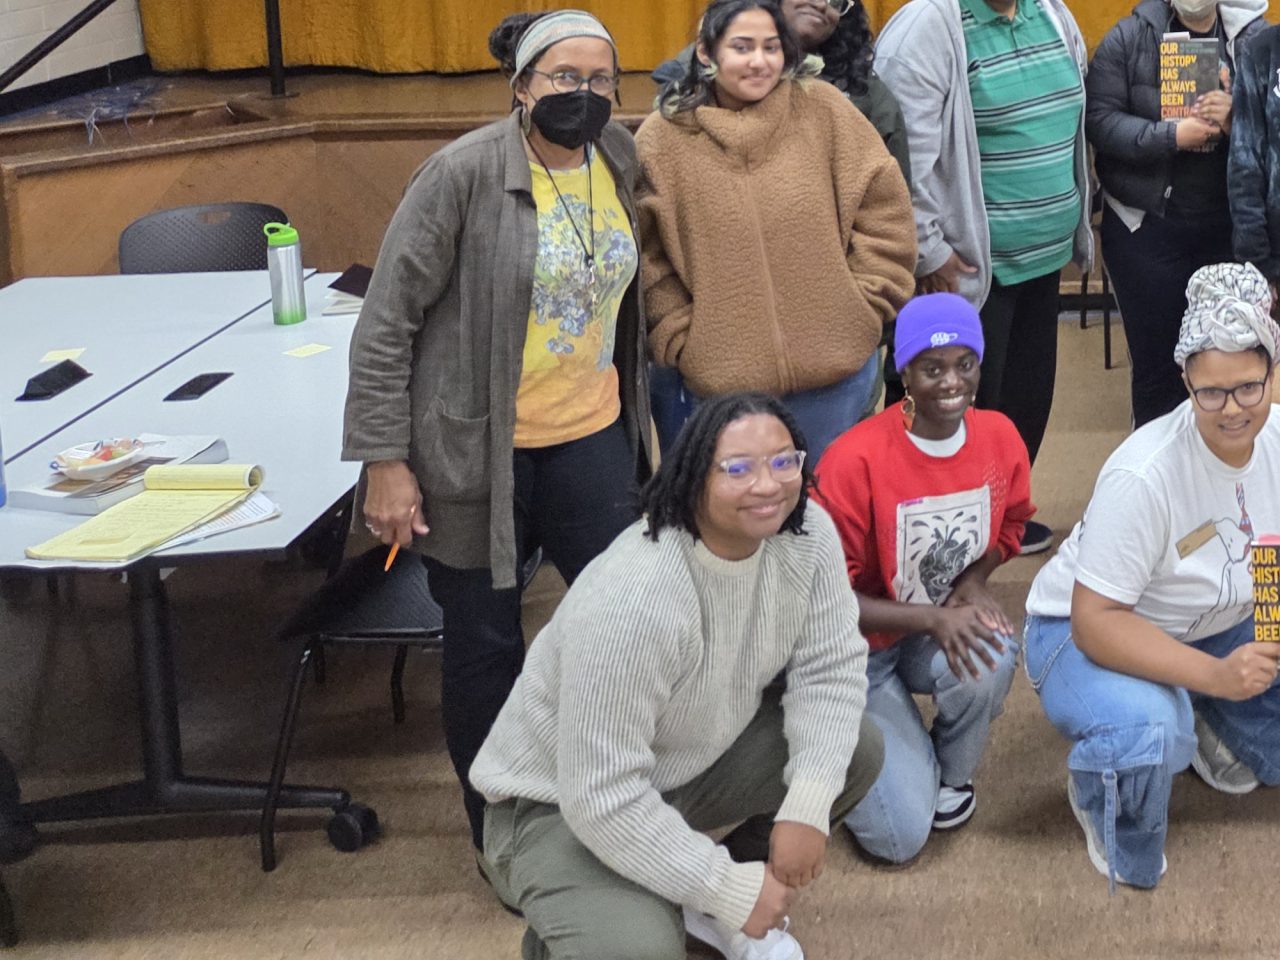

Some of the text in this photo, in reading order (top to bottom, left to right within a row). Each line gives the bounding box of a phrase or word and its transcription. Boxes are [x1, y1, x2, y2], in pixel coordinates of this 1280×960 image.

[1160, 43, 1178, 54] OUR
[1160, 55, 1197, 67] HISTORY
[1160, 68, 1178, 80] HAS
[1161, 81, 1196, 92] ALWAYS
[1161, 94, 1183, 105] BEEN
[1252, 548, 1276, 565] OUR
[1253, 586, 1279, 603] HAS
